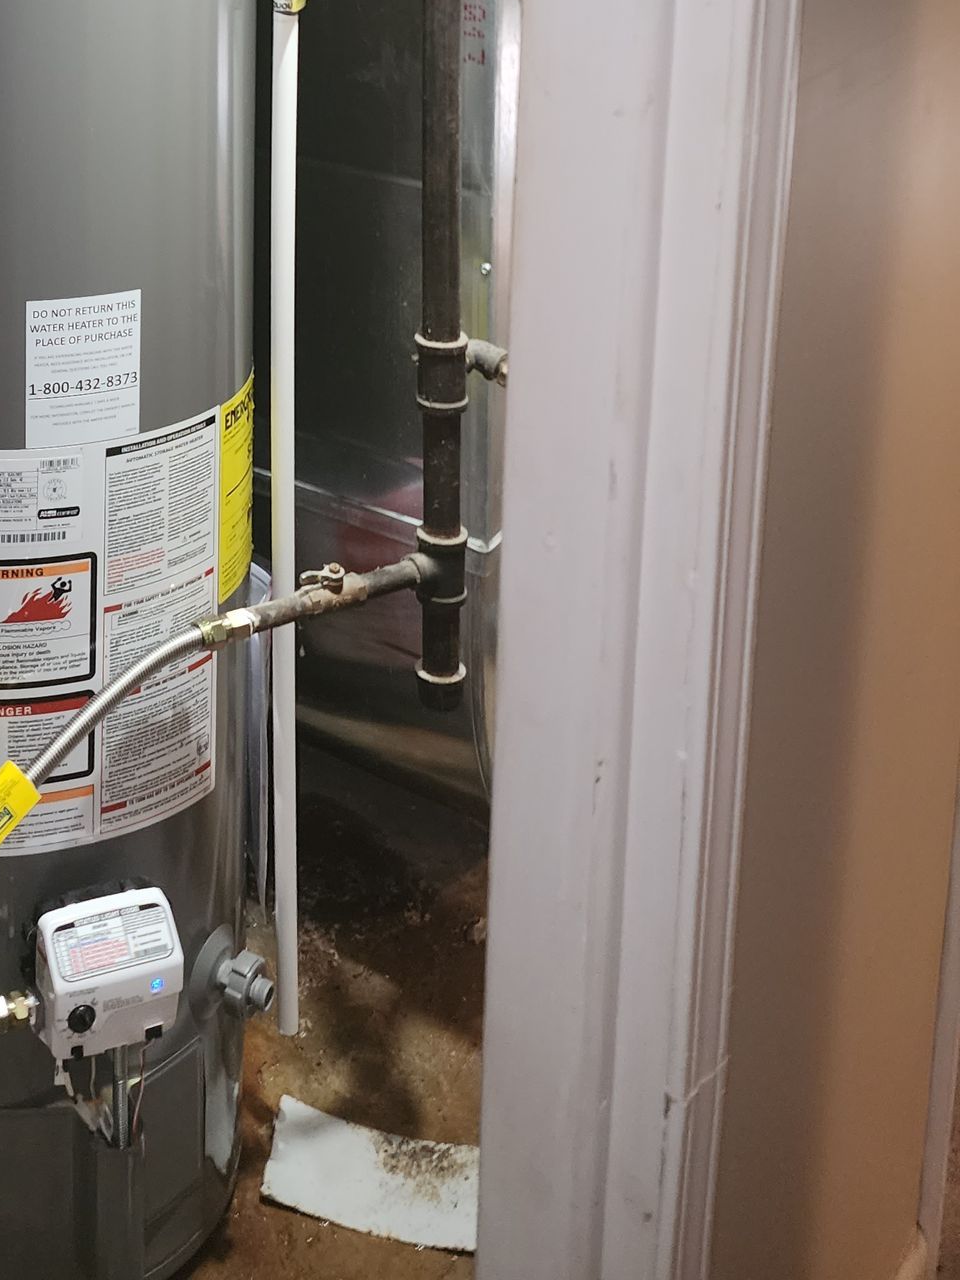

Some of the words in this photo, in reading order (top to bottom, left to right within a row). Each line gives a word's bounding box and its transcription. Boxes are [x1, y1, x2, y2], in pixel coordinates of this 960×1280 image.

[32, 310, 48, 319] DO
[51, 308, 72, 318] NOT
[75, 303, 113, 316] RETURN
[116, 300, 136, 311] THIS
[30, 323, 64, 333] WATER
[67, 319, 104, 331] HEATER
[106, 316, 119, 326] TO
[120, 313, 138, 324] THE
[35, 336, 65, 347] PLACE
[68, 335, 82, 345] OF
[84, 328, 133, 343] PURCHASE
[29, 371, 138, 396] 1-800-432-8373
